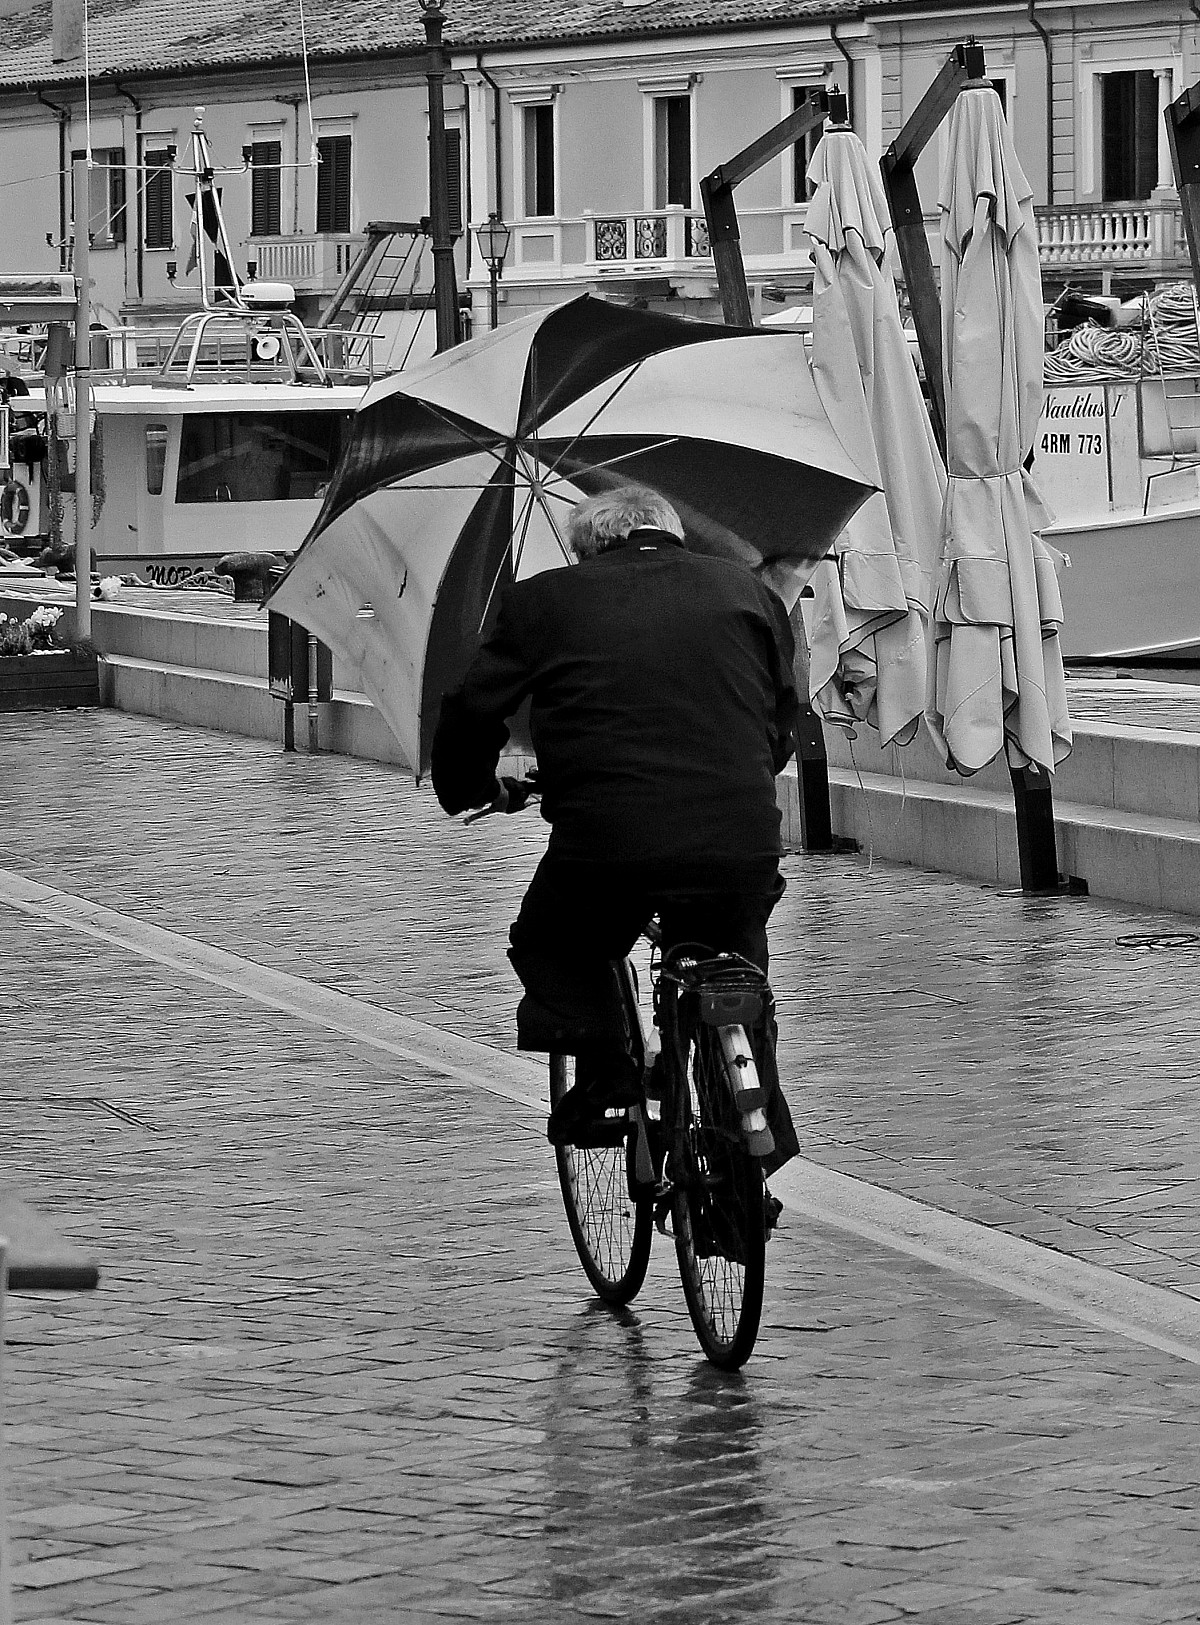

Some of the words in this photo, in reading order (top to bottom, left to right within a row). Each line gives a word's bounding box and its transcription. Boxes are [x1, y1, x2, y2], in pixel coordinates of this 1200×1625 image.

[1040, 393, 1104, 419] Nautilus
[1041, 433, 1070, 454] 4RM
[1078, 434, 1102, 455] 773
